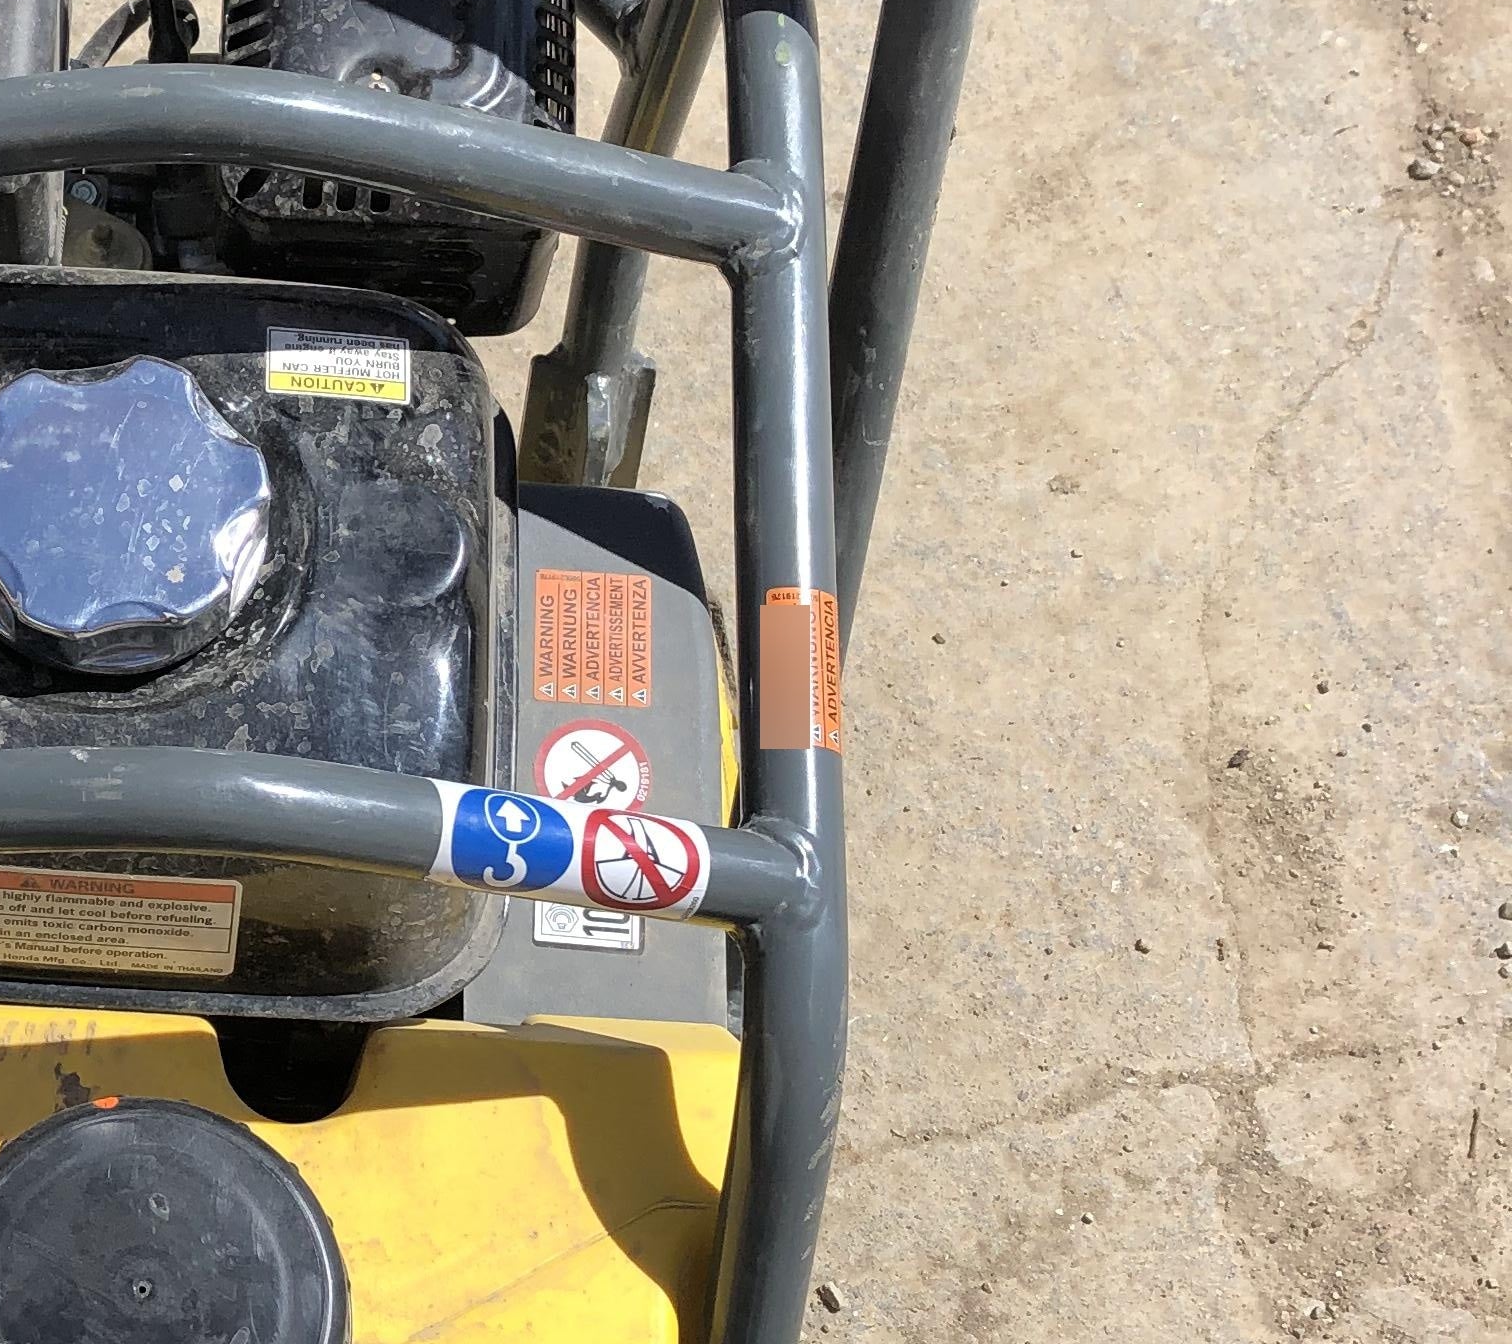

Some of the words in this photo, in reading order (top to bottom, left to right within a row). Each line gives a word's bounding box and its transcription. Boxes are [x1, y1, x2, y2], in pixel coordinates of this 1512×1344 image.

[296, 333, 342, 345] running.
[346, 338, 376, 348] been
[380, 341, 400, 351] has
[284, 342, 324, 352] engine
[328, 346, 336, 354] if
[340, 346, 370, 356] away
[336, 357, 361, 366] YOU
[374, 348, 400, 362] Stay
[282, 362, 308, 372] CAN
[314, 364, 370, 377] MUFFLER
[366, 360, 400, 370] BURN
[375, 370, 400, 380] HOT
[291, 376, 366, 392] CAUTION
[539, 595, 554, 677] WARNING
[562, 588, 577, 678] WARNUNG
[586, 577, 600, 682] ADVERTENCIA
[609, 578, 623, 682] ADVERTISSEMENT
[632, 579, 646, 684] AVVERTENZA
[824, 600, 838, 724] ADVERTENCIA
[637, 761, 649, 802] 0219181
[50, 879, 135, 894] WARNING
[2, 890, 41, 902] highly
[46, 894, 115, 906] flammable
[120, 899, 143, 908] and
[148, 902, 211, 912] explosive.
[8, 903, 26, 912] off
[30, 905, 54, 914] and
[58, 907, 74, 916] let
[78, 908, 106, 918] cool
[110, 910, 152, 920] before
[156, 913, 216, 926] refueling.
[4, 917, 38, 928] emits
[42, 920, 74, 930] toxic
[78, 922, 124, 932] carbon
[128, 926, 194, 938] monoxide.
[0, 928, 11, 937] in
[16, 930, 30, 938] an
[35, 931, 92, 942] enclosed
[96, 936, 128, 944] area.
[14, 942, 60, 953] Manual
[63, 944, 102, 954] before
[106, 949, 168, 960] operation.
[4, 952, 40, 962] Honda
[42, 956, 68, 965] Mfg.
[131, 962, 159, 970] MADE
[176, 966, 224, 974] THAILAND
